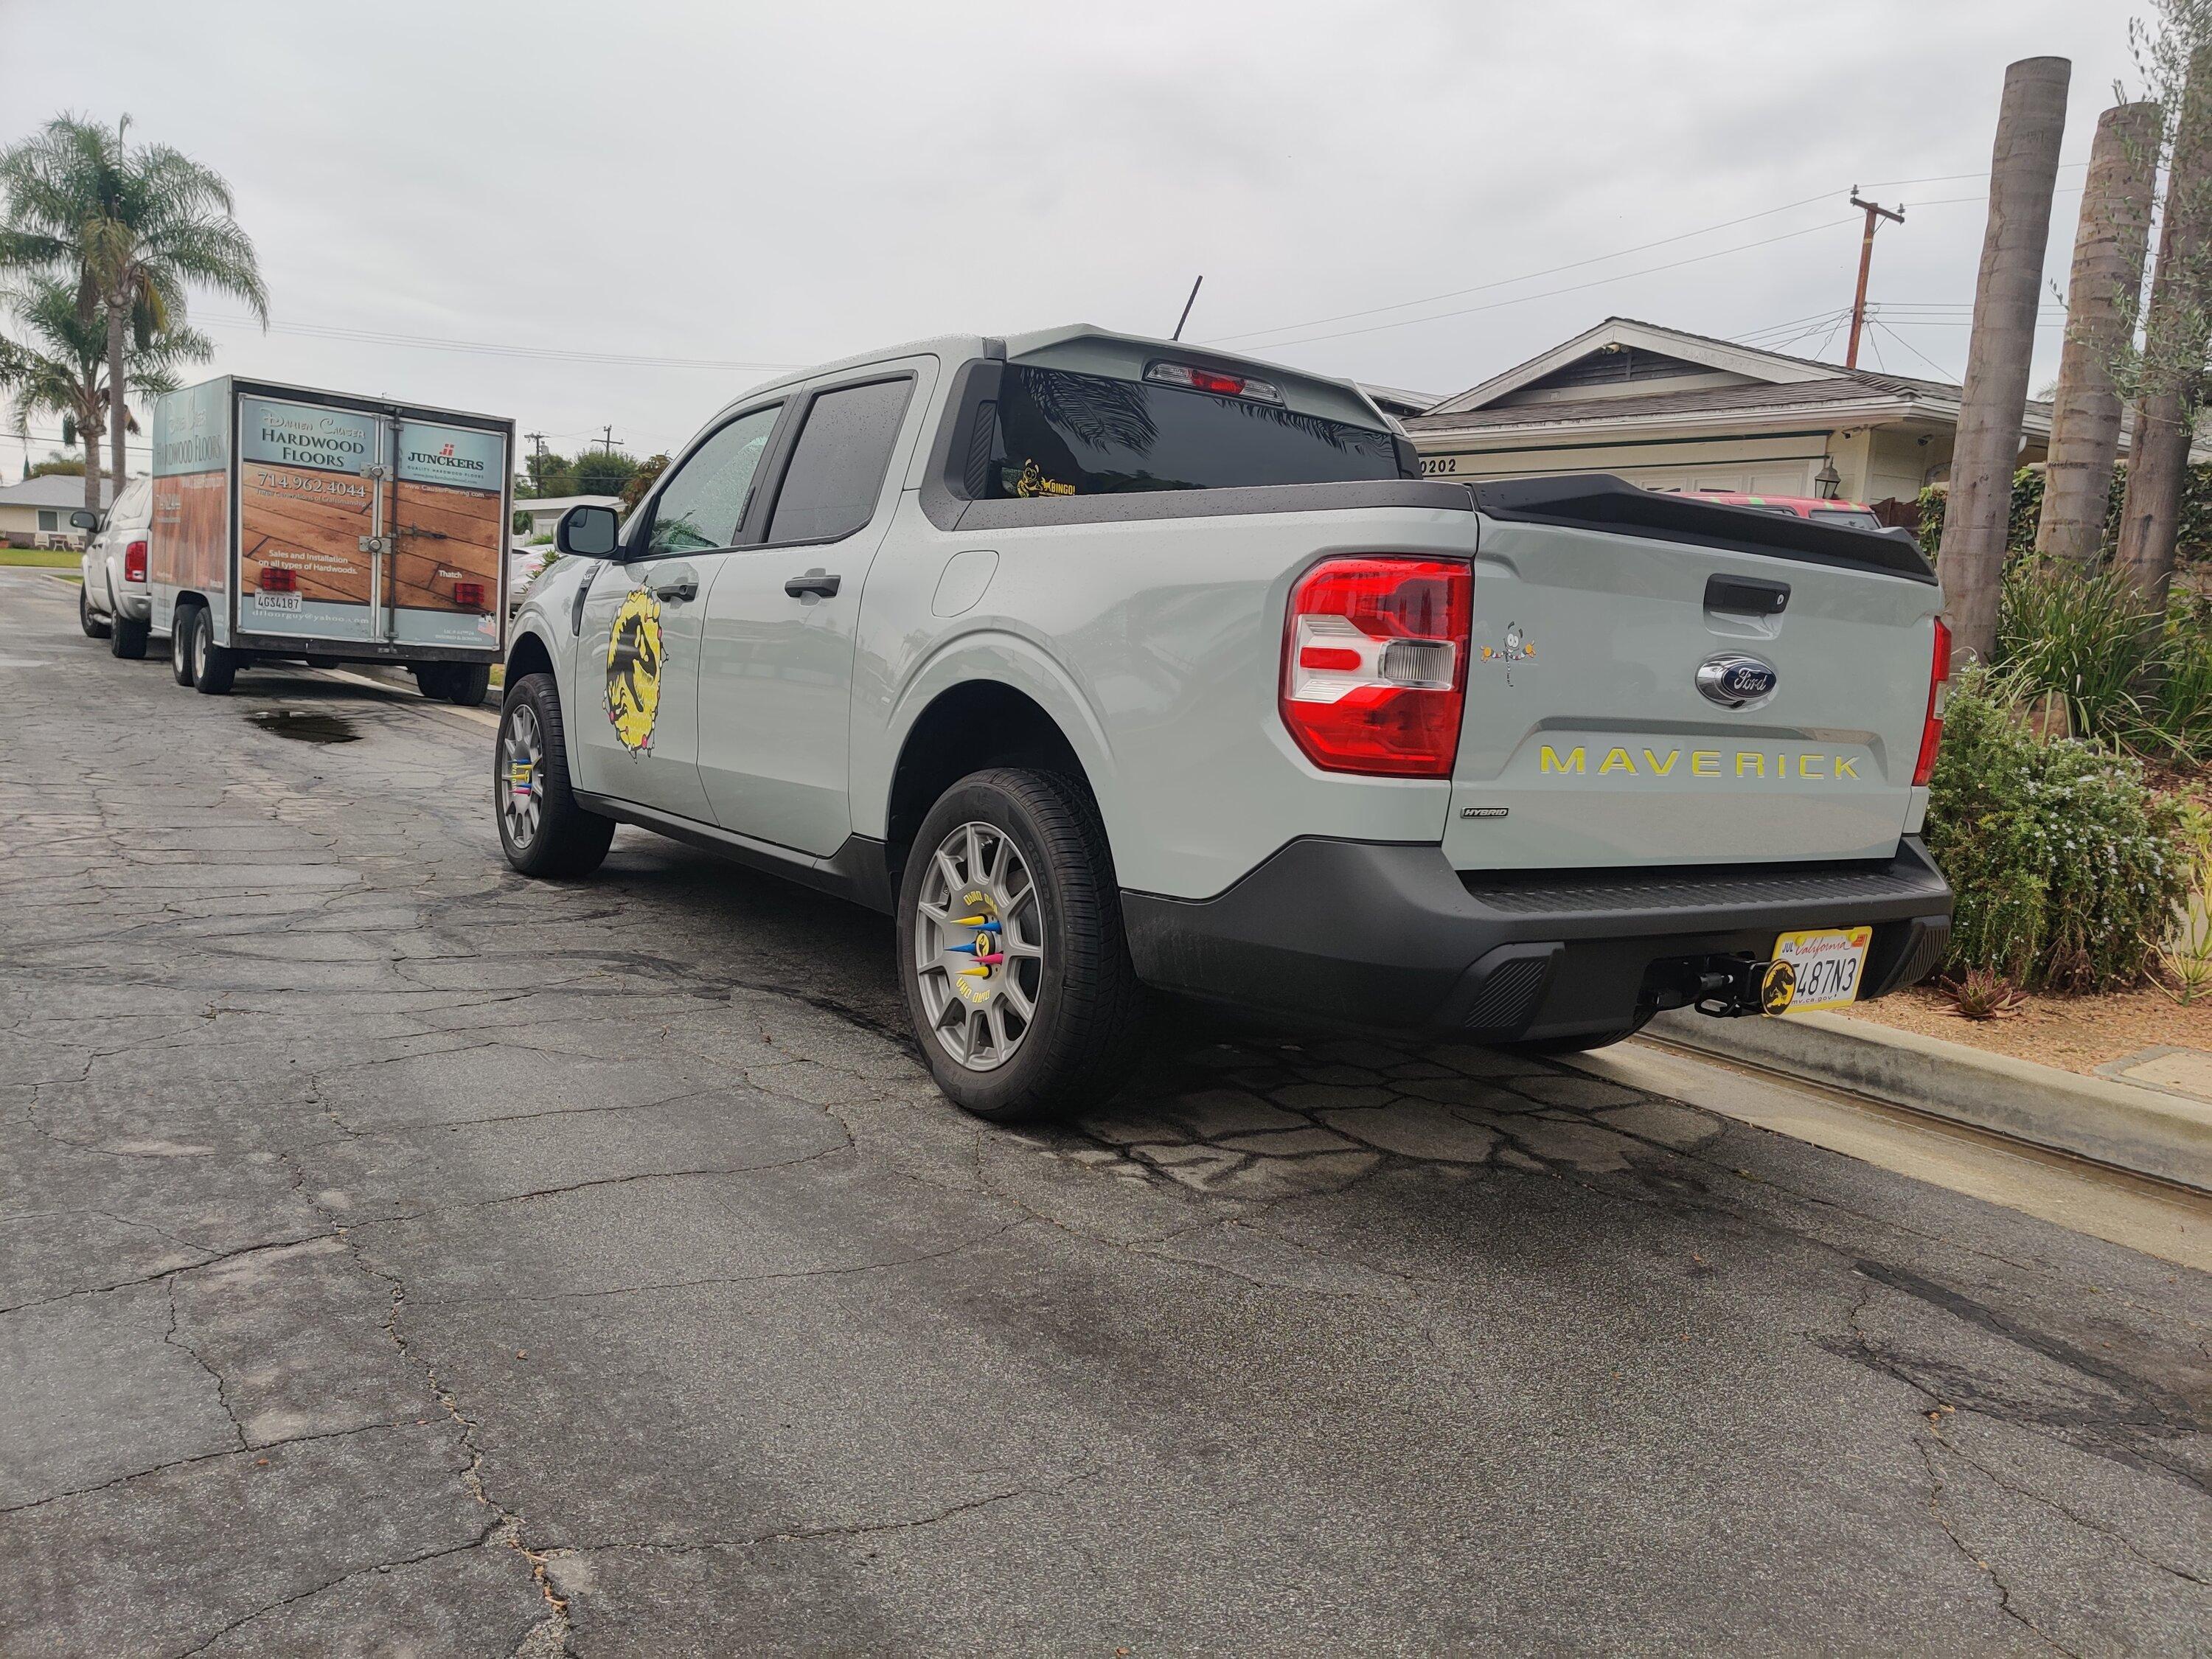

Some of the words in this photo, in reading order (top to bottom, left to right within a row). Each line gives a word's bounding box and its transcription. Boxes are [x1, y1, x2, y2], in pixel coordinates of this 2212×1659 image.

[195, 434, 221, 462] FLOORS
[262, 428, 365, 454] HARDWOOD
[282, 447, 345, 467] FLOORS
[408, 452, 484, 470] JUNCKERS
[1420, 459, 1456, 473] 0202
[258, 472, 366, 498] 714.962.4044
[1051, 482, 1076, 495] BINGO!
[268, 549, 288, 558] Sales
[291, 552, 305, 560] and
[307, 552, 348, 563] Installation
[282, 561, 302, 570] types
[438, 570, 462, 579] Thatch
[258, 597, 299, 609] 4GS4187
[1733, 667, 1767, 691] Ford
[1540, 745, 1860, 779] MAVERICK
[1781, 942, 1793, 953] JUL
[1795, 936, 1850, 959] California
[1792, 958, 1857, 996] 487N3
[1791, 995, 1832, 1005] mv.ca.gov
